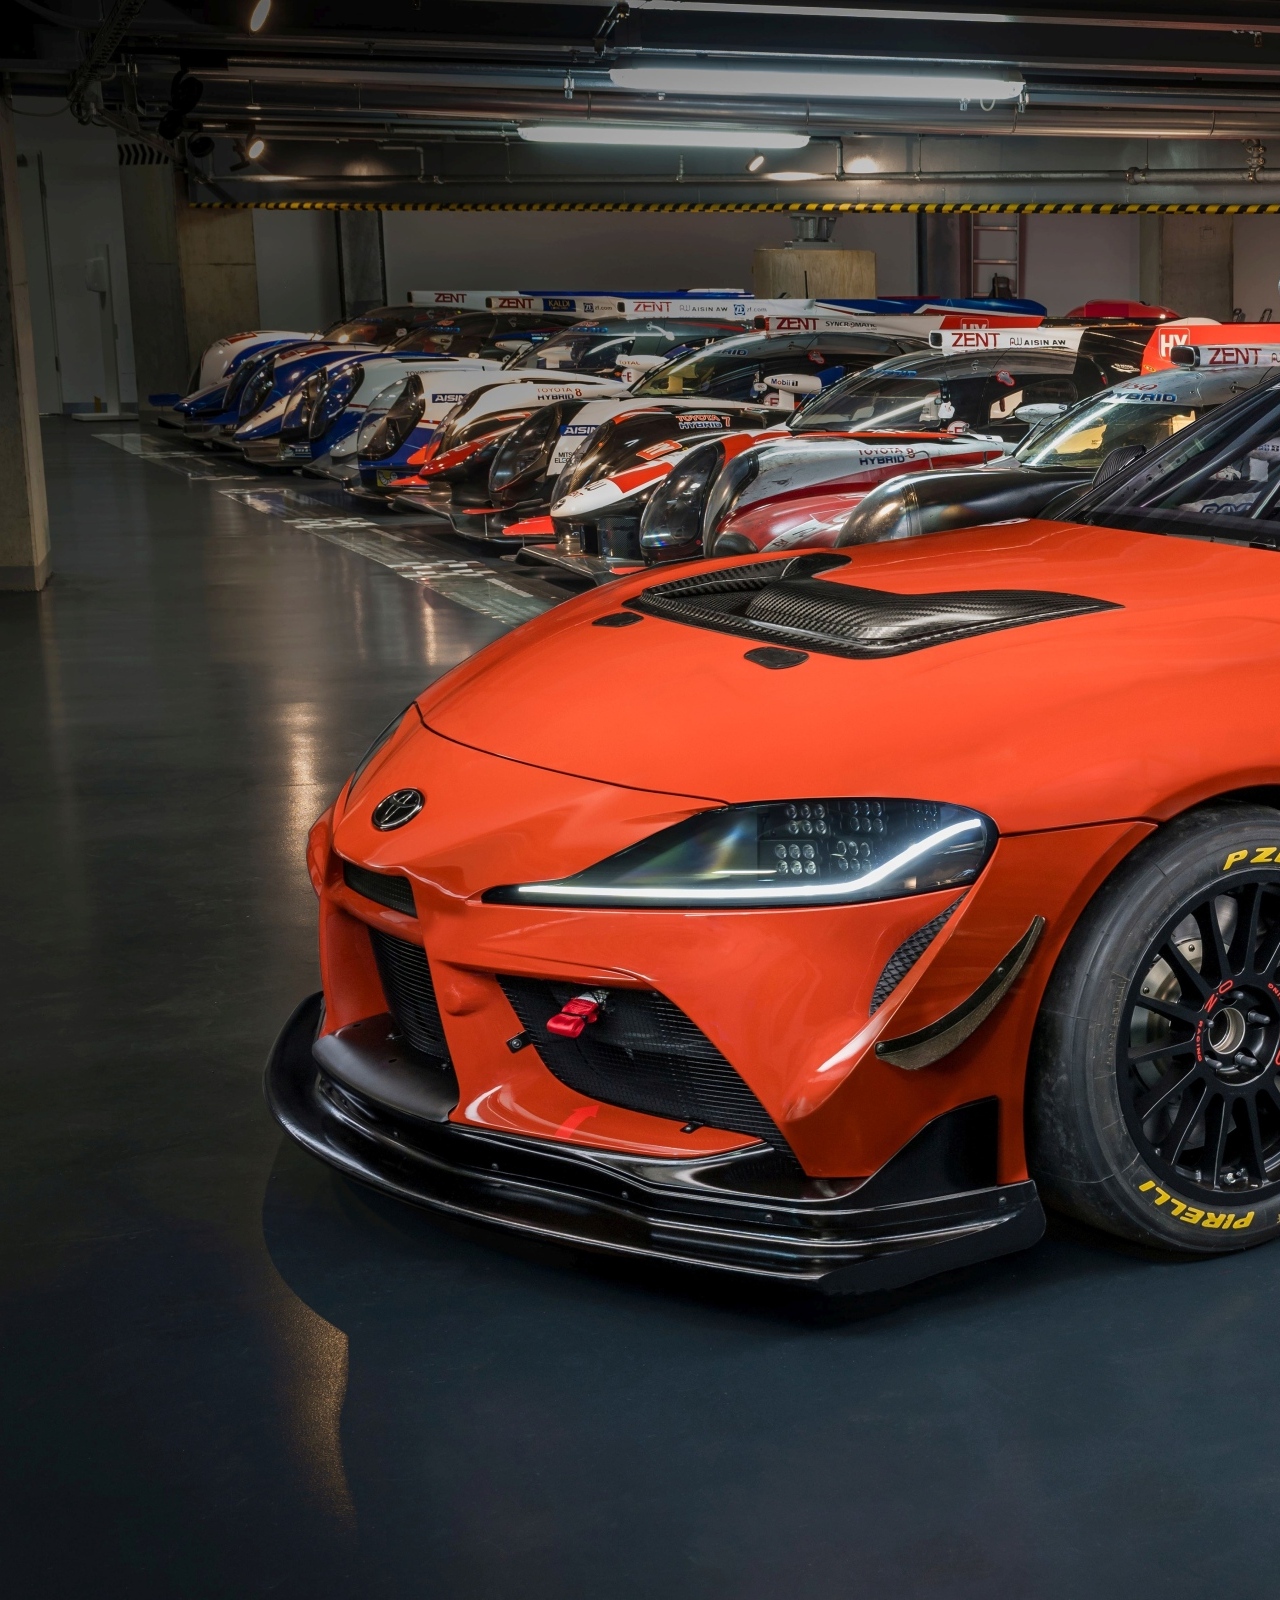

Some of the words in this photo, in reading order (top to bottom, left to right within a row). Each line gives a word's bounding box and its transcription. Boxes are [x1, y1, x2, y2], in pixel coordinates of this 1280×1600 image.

[434, 293, 467, 303] ZENT
[498, 298, 534, 309] ZENT
[633, 302, 672, 312] ZENT
[776, 317, 819, 330] ZENT
[951, 333, 1000, 347] ZENT
[1209, 348, 1262, 365] ZENT
[770, 378, 791, 386] Mobil
[574, 388, 582, 397] 8
[679, 421, 723, 429] HYBRID
[721, 416, 731, 428] 7
[858, 447, 903, 456] TOYOTA
[859, 455, 905, 466] HYBRID
[1222, 849, 1249, 871] P
[1195, 1020, 1204, 1062] RACING
[1138, 1180, 1255, 1230] PIRELLI
